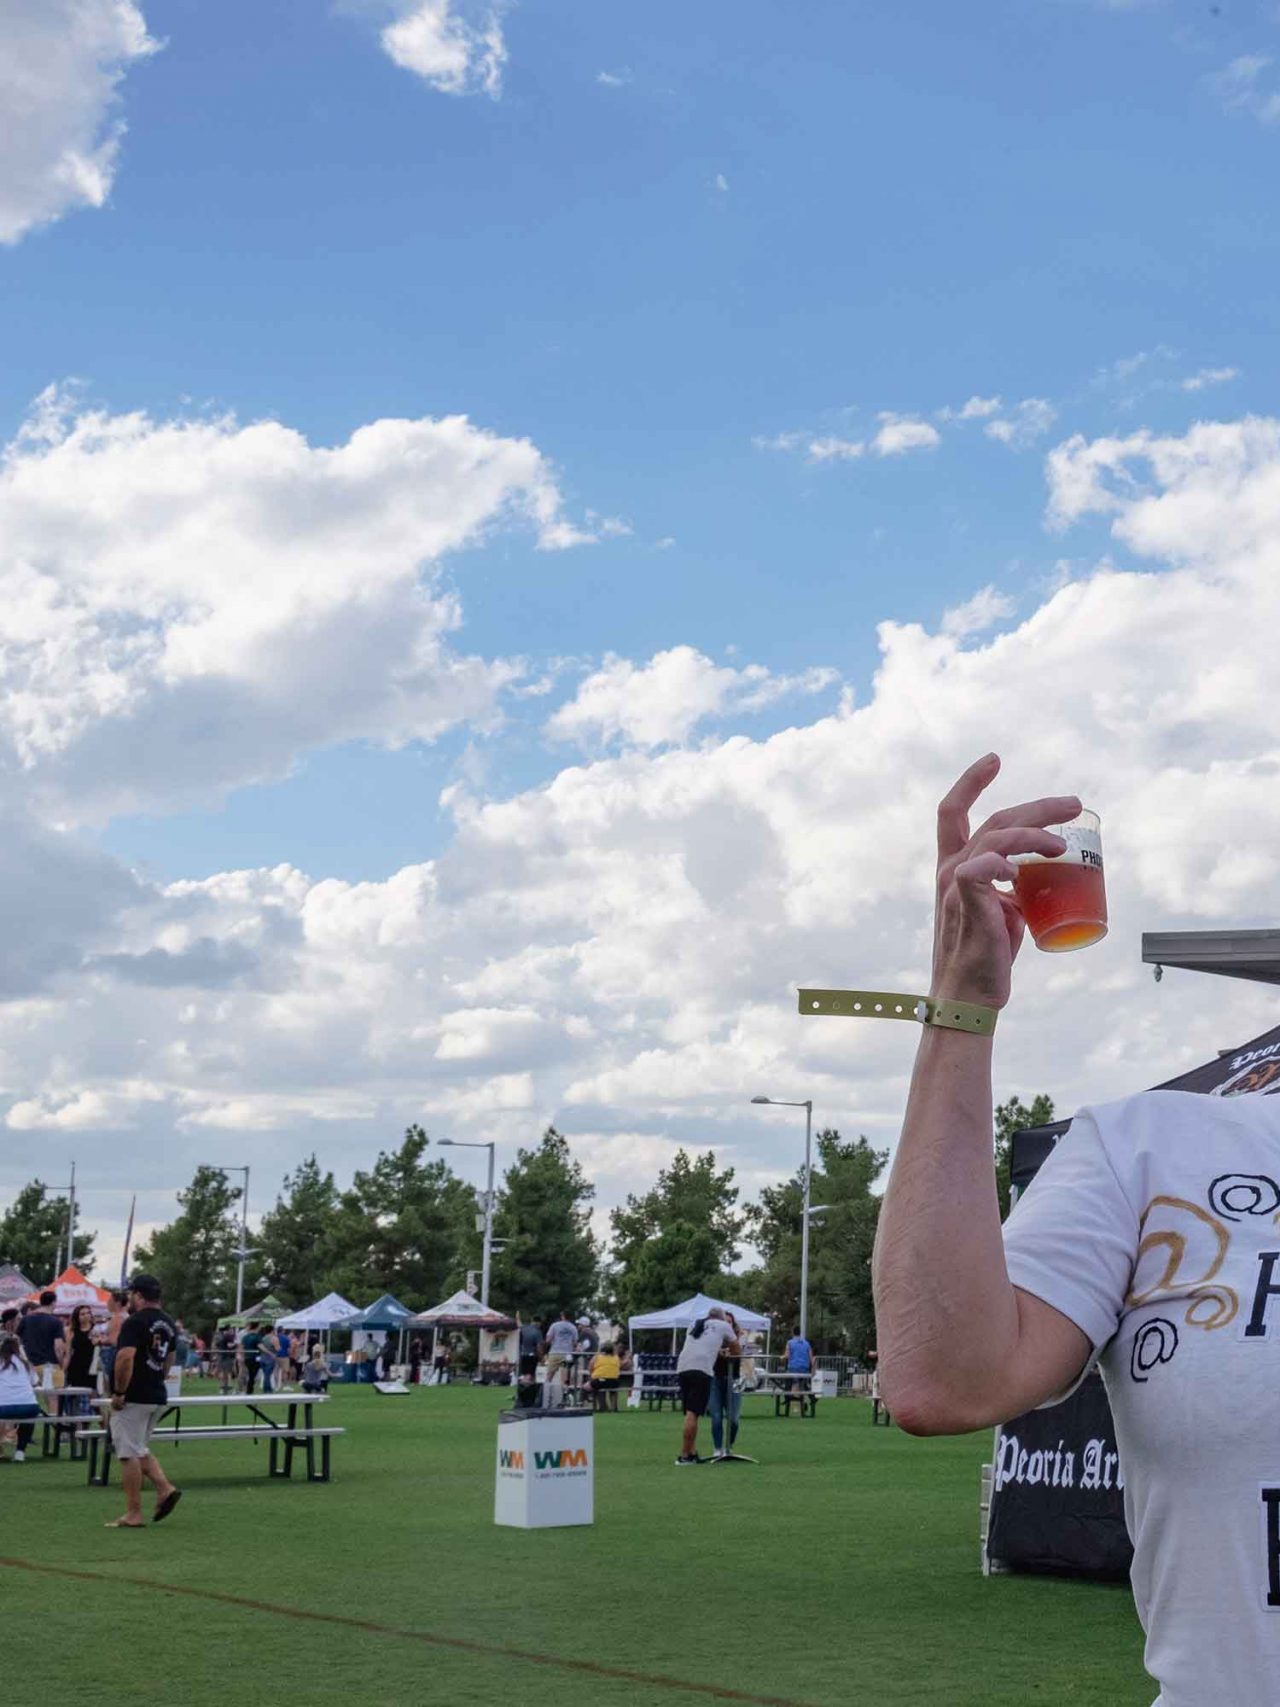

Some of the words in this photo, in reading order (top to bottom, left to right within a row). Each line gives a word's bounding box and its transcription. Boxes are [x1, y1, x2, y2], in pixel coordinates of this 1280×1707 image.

[500, 1449, 524, 1470] WM
[533, 1448, 588, 1469] WM
[996, 1434, 1074, 1492] Peoria
